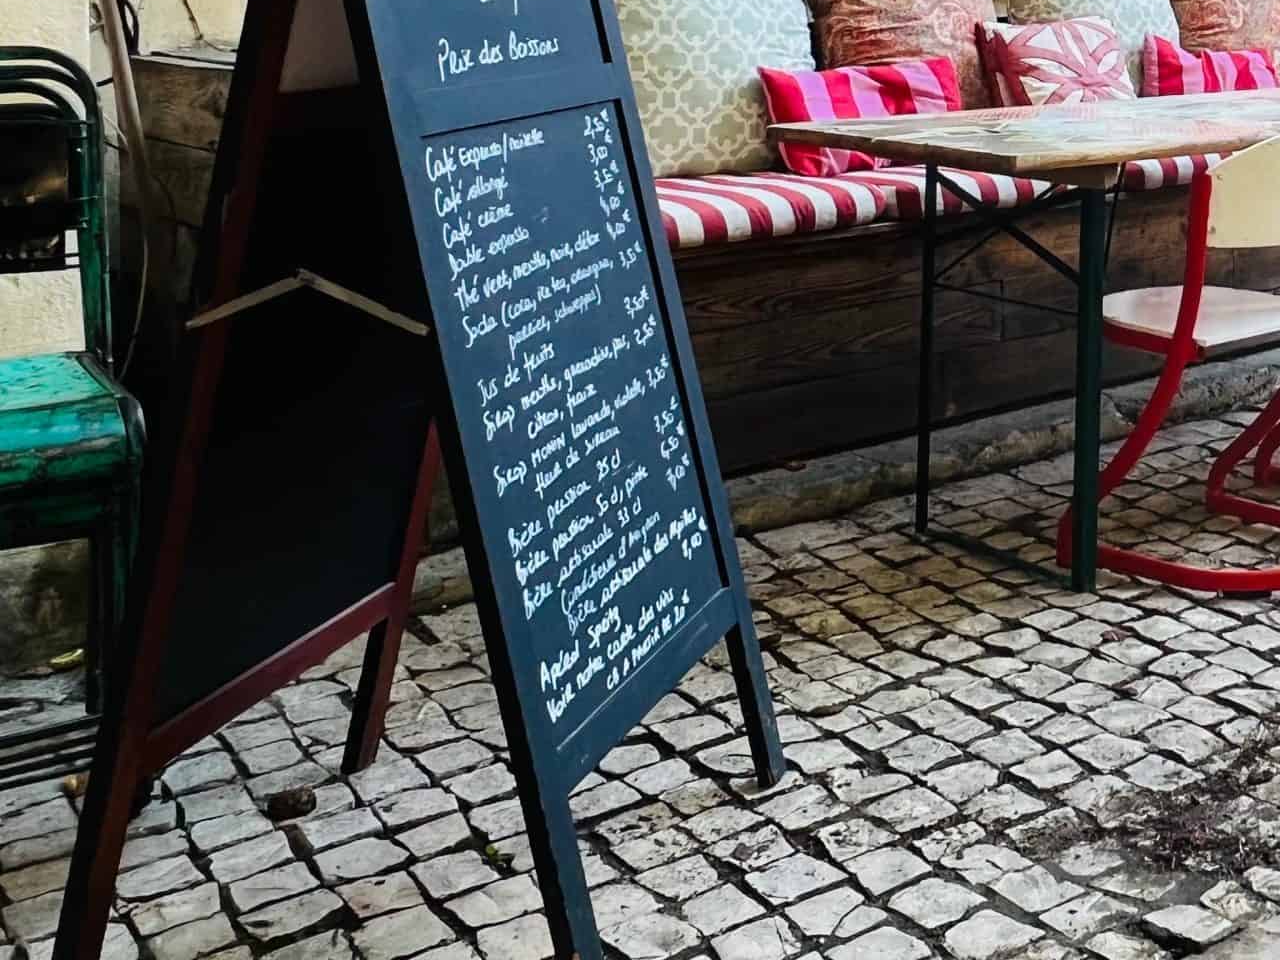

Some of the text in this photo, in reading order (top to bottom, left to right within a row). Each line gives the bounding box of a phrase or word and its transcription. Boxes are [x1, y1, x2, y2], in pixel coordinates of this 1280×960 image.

[478, 39, 504, 64] des
[425, 145, 458, 183] Café
[434, 178, 463, 217] Café
[443, 210, 473, 248] Café
[503, 363, 521, 388] de
[566, 446, 581, 469] de
[638, 604, 655, 632] des
